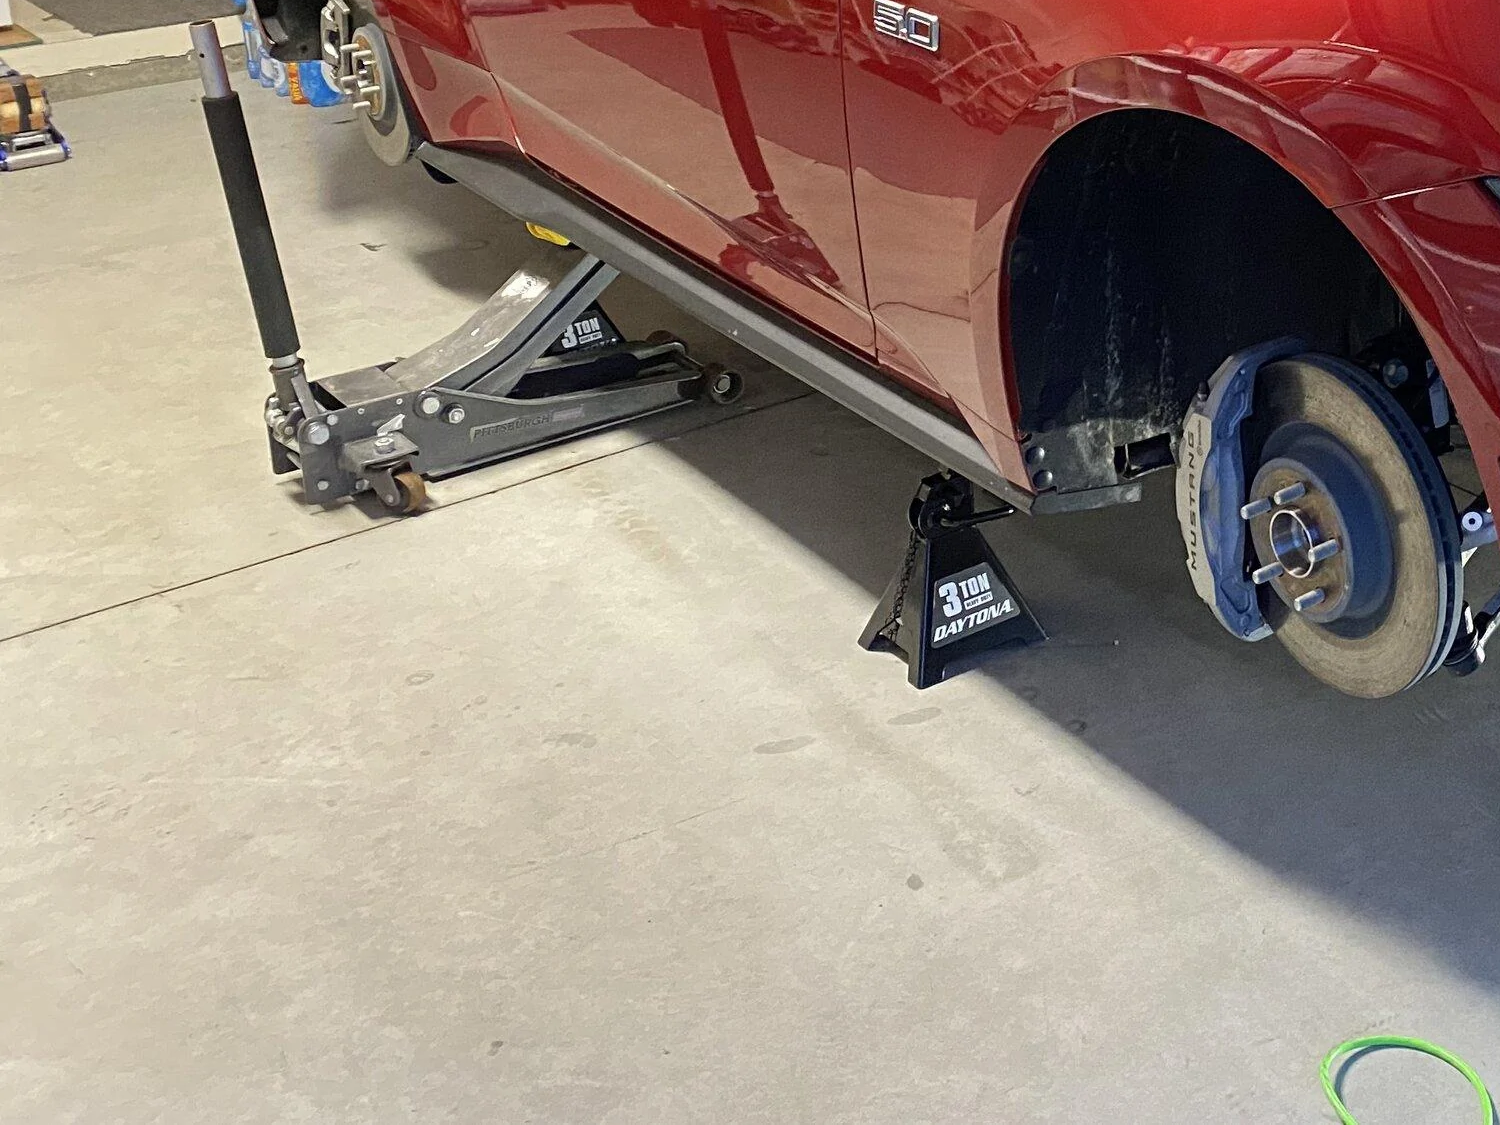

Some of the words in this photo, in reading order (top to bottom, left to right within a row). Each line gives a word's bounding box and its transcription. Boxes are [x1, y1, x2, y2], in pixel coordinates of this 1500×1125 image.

[574, 317, 600, 336] TON
[1187, 431, 1198, 571] MUSTANG
[938, 581, 963, 618] 3
[958, 572, 991, 599] TON
[933, 599, 1014, 643] DAYTONA
